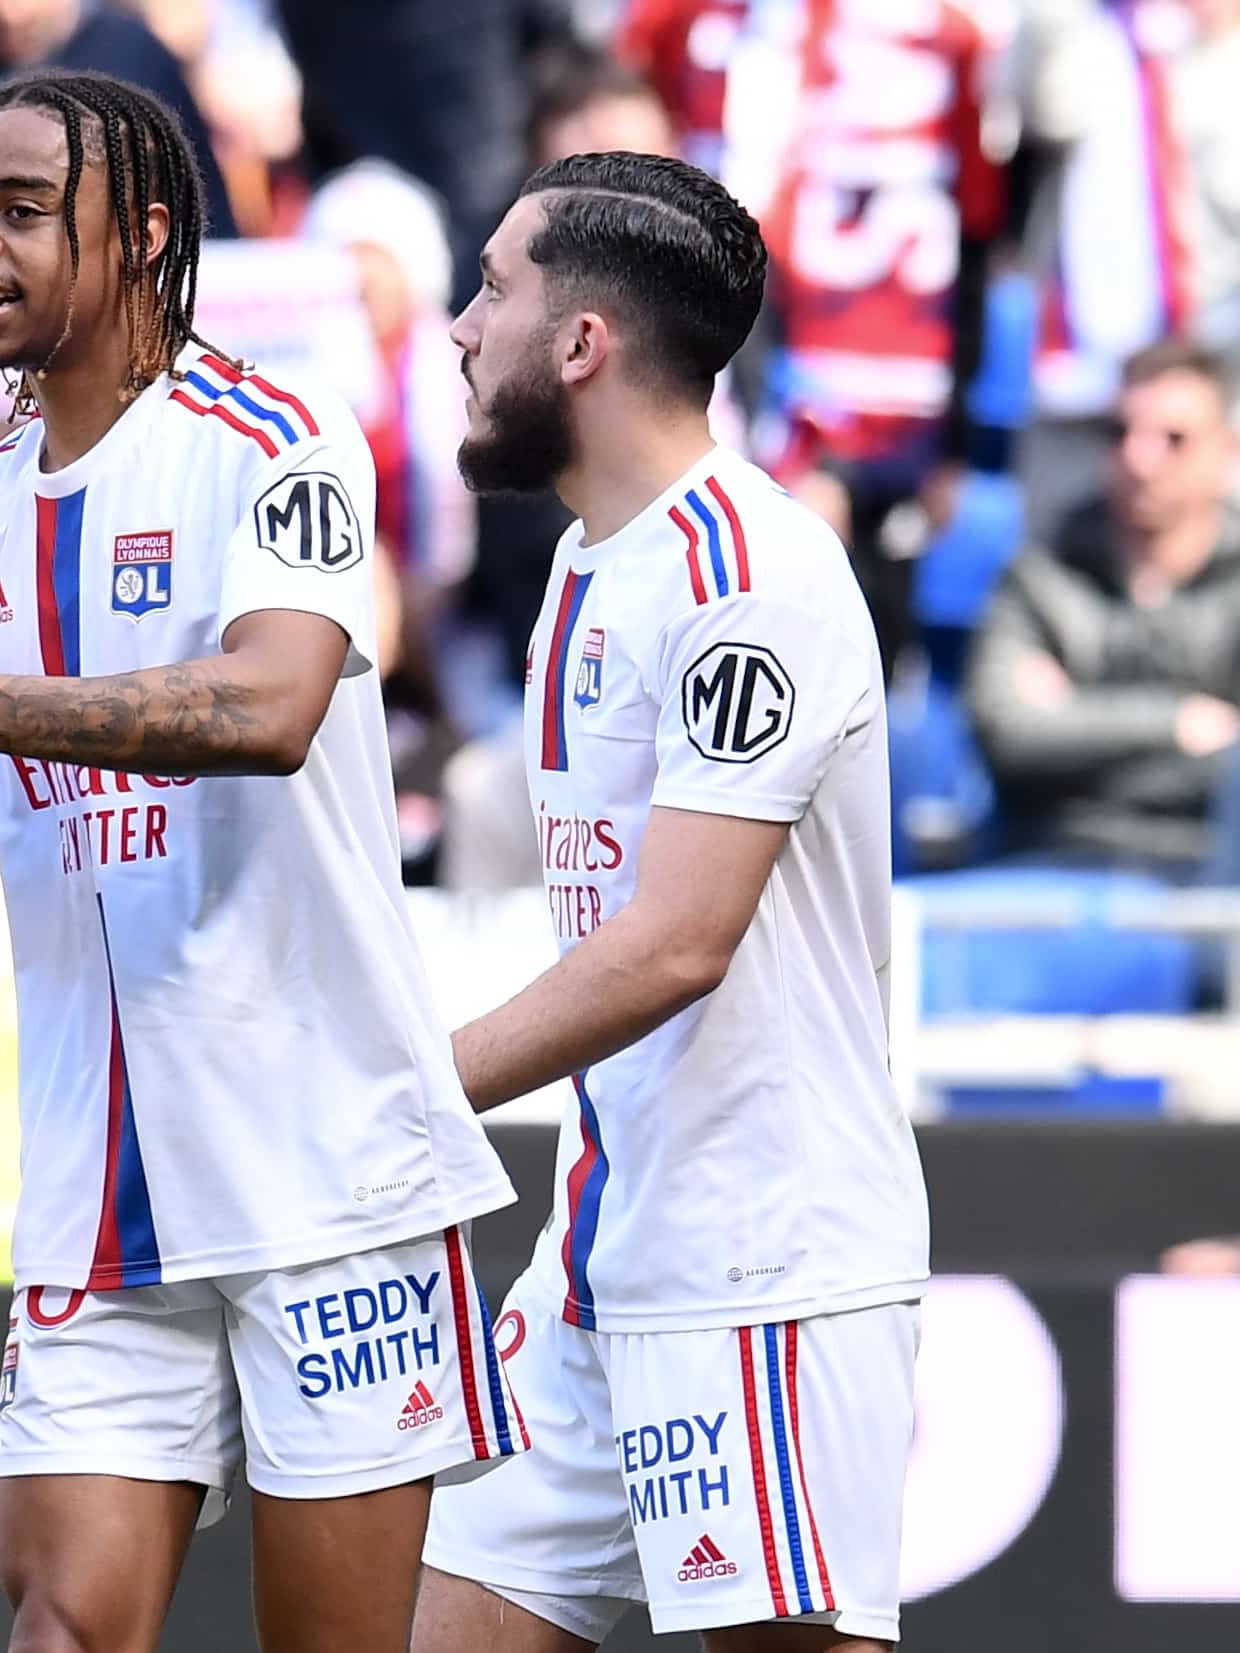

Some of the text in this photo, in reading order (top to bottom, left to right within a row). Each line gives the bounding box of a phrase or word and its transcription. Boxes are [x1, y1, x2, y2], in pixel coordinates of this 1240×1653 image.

[116, 536, 169, 550] OLYMPIQUE
[116, 547, 169, 561] LYONNAIS
[266, 480, 353, 566] MG
[692, 653, 785, 753] MG
[539, 800, 623, 871] irates
[284, 1271, 441, 1345] TEDDY
[297, 1323, 440, 1399] SMITH
[396, 1405, 444, 1431] adidas
[615, 1411, 729, 1475] EDDY
[629, 1465, 730, 1527] MITH
[677, 1559, 738, 1582] adidas
